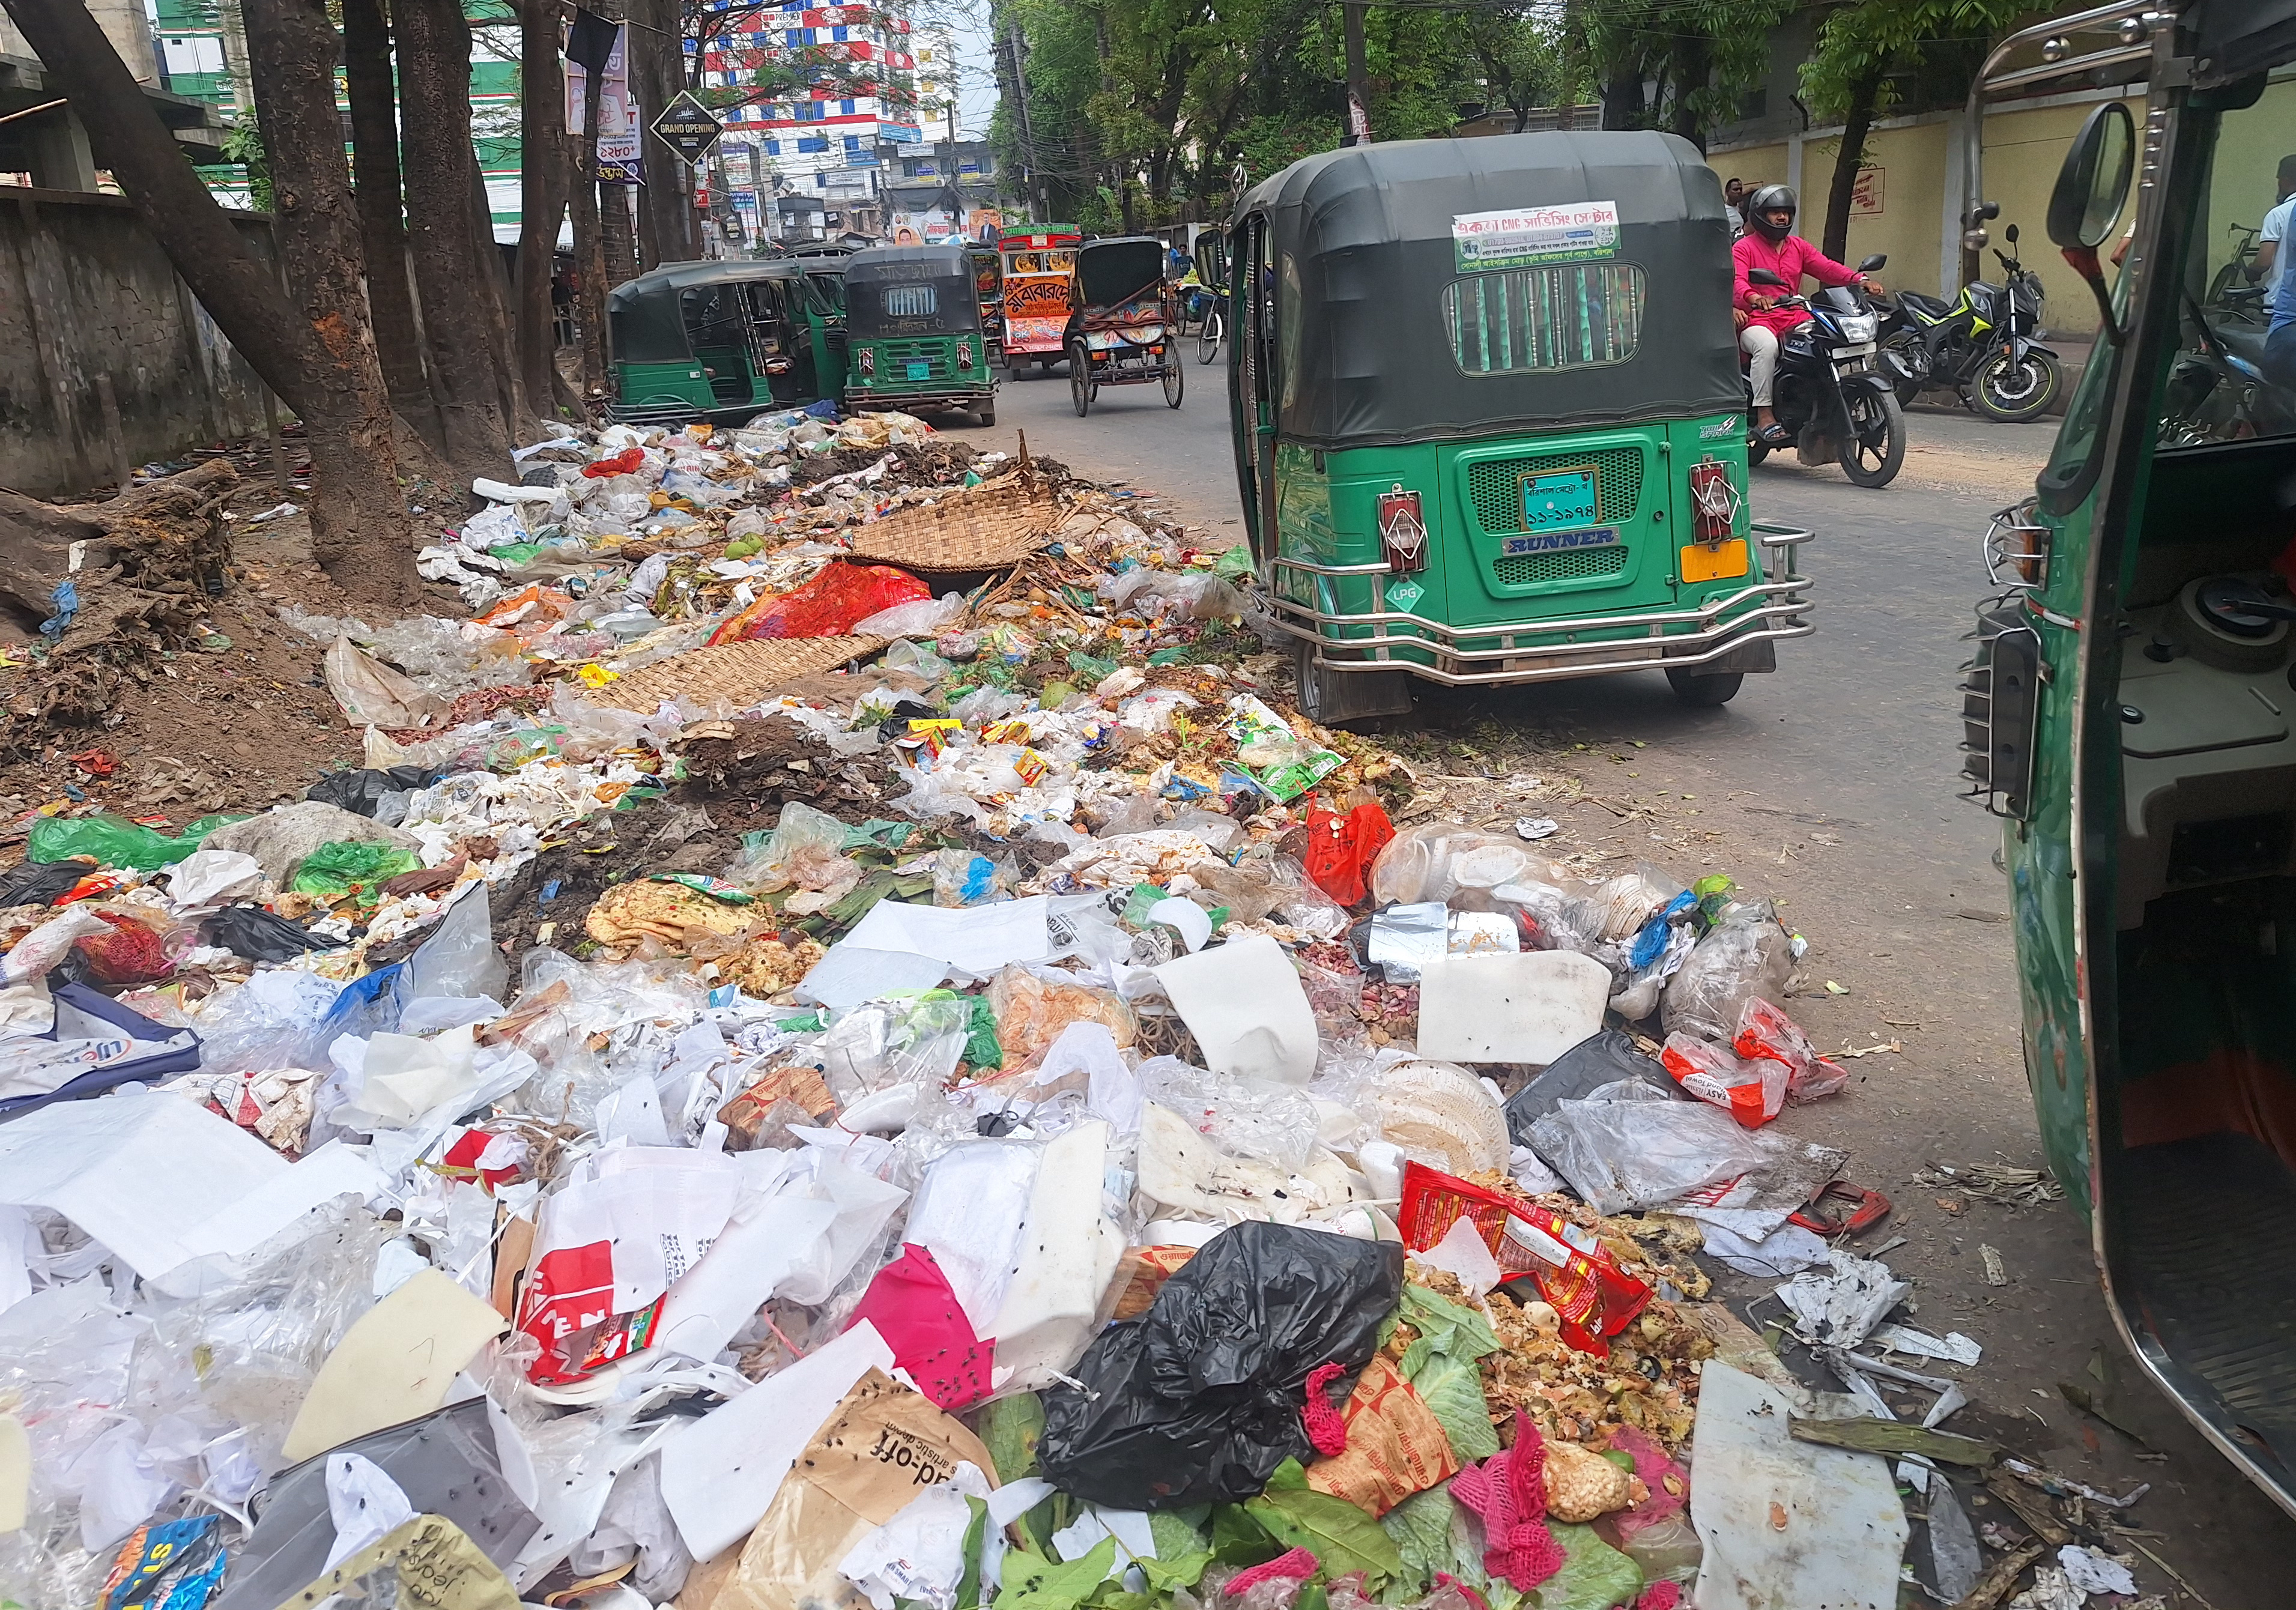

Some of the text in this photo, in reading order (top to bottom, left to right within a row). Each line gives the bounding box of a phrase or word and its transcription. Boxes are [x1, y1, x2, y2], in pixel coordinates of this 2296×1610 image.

[775, 12, 801, 22] PREMIER
[660, 124, 715, 133] GRAND OPENING
[1501, 218, 1521, 230] CNG
[1524, 211, 1570, 228] সার্ভিসিং
[1699, 429, 1734, 439] SPARK
[1527, 486, 1554, 497] বরিশাল
[1528, 505, 1595, 525] ১১-১৯৭৪
[1508, 530, 1614, 553] RUNNER
[1392, 587, 1417, 601] LPG
[1686, 1076, 1704, 1086] Towel
[1707, 1090, 1727, 1101] EASY
[915, 1439, 949, 1471] artistic
[894, 1568, 913, 1586] SMART
